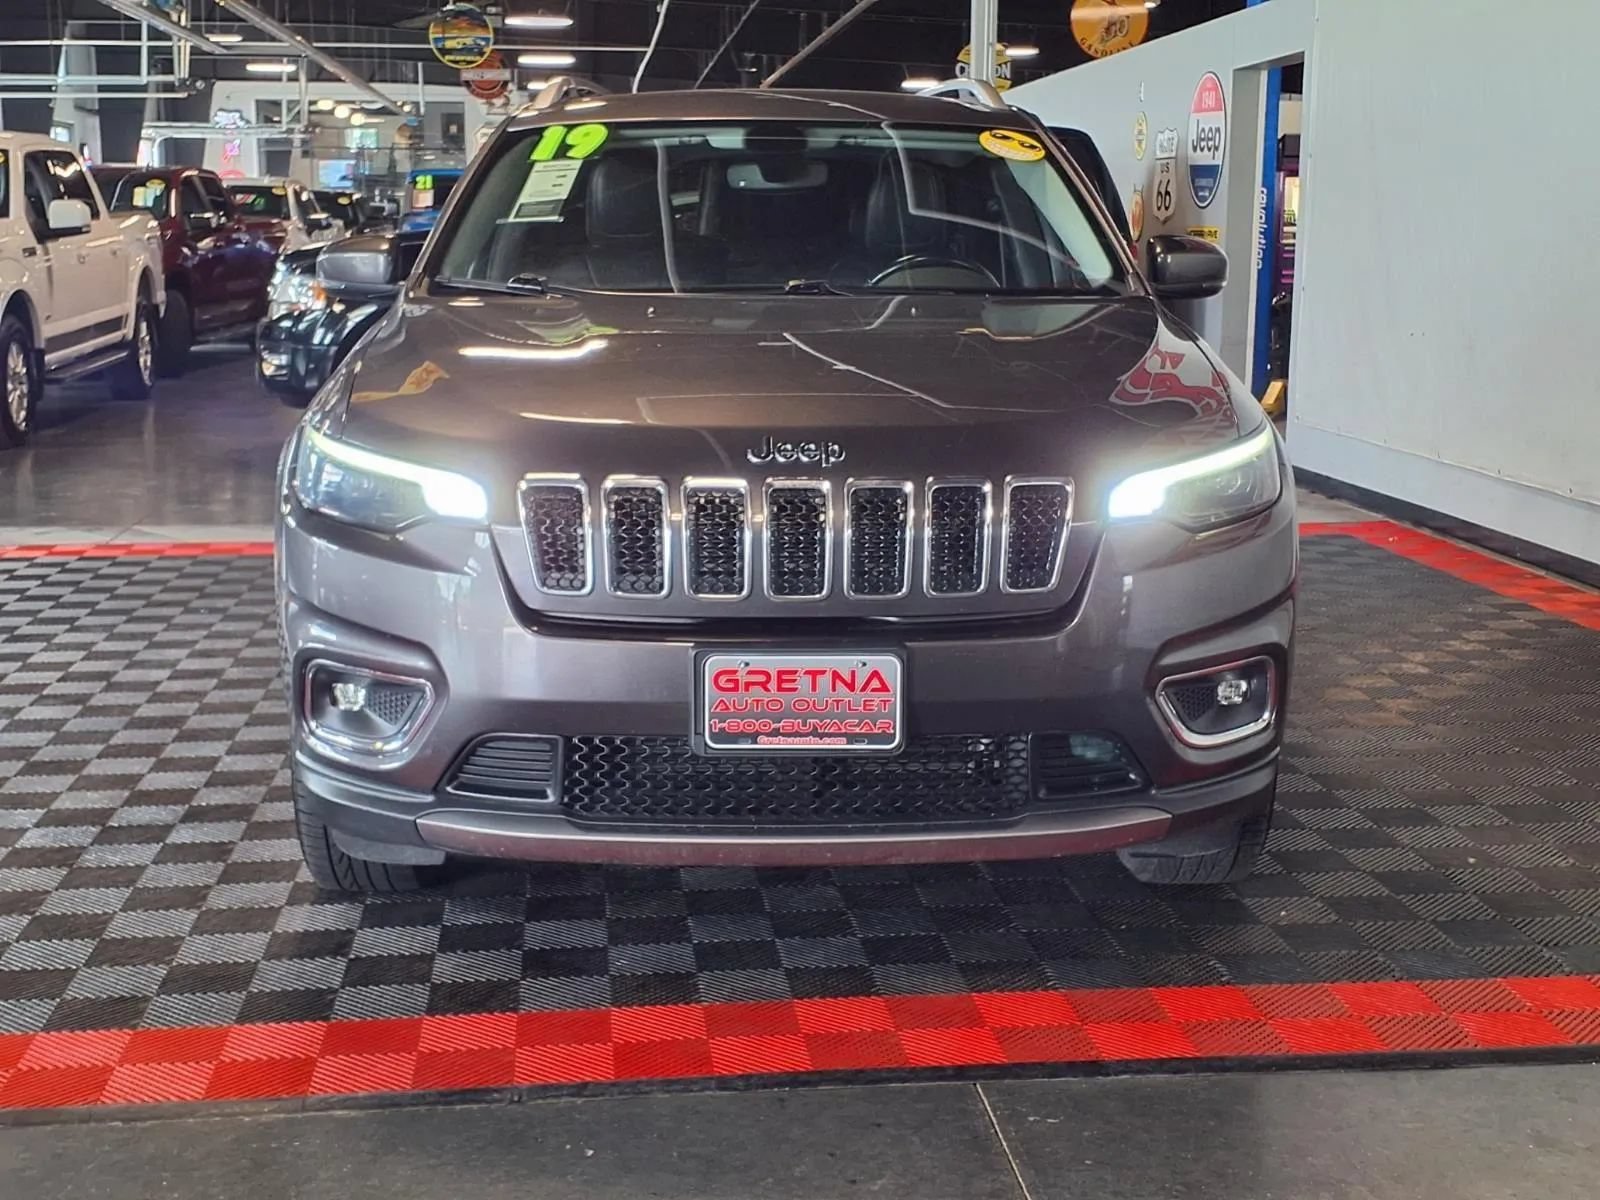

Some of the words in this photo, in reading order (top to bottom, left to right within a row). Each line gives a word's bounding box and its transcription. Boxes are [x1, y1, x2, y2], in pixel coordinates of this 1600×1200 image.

[1201, 90, 1216, 109] 1941
[527, 124, 609, 161] 19
[1192, 119, 1221, 160] Jeep
[1160, 161, 1170, 174] US
[415, 175, 433, 190] 21
[1156, 178, 1172, 211] 66
[746, 435, 847, 468] Jeep
[712, 667, 893, 694] GRETNA
[711, 698, 785, 713] AUTO
[790, 698, 895, 713] OUTLET
[710, 719, 895, 734] 1-800-BUYACAR
